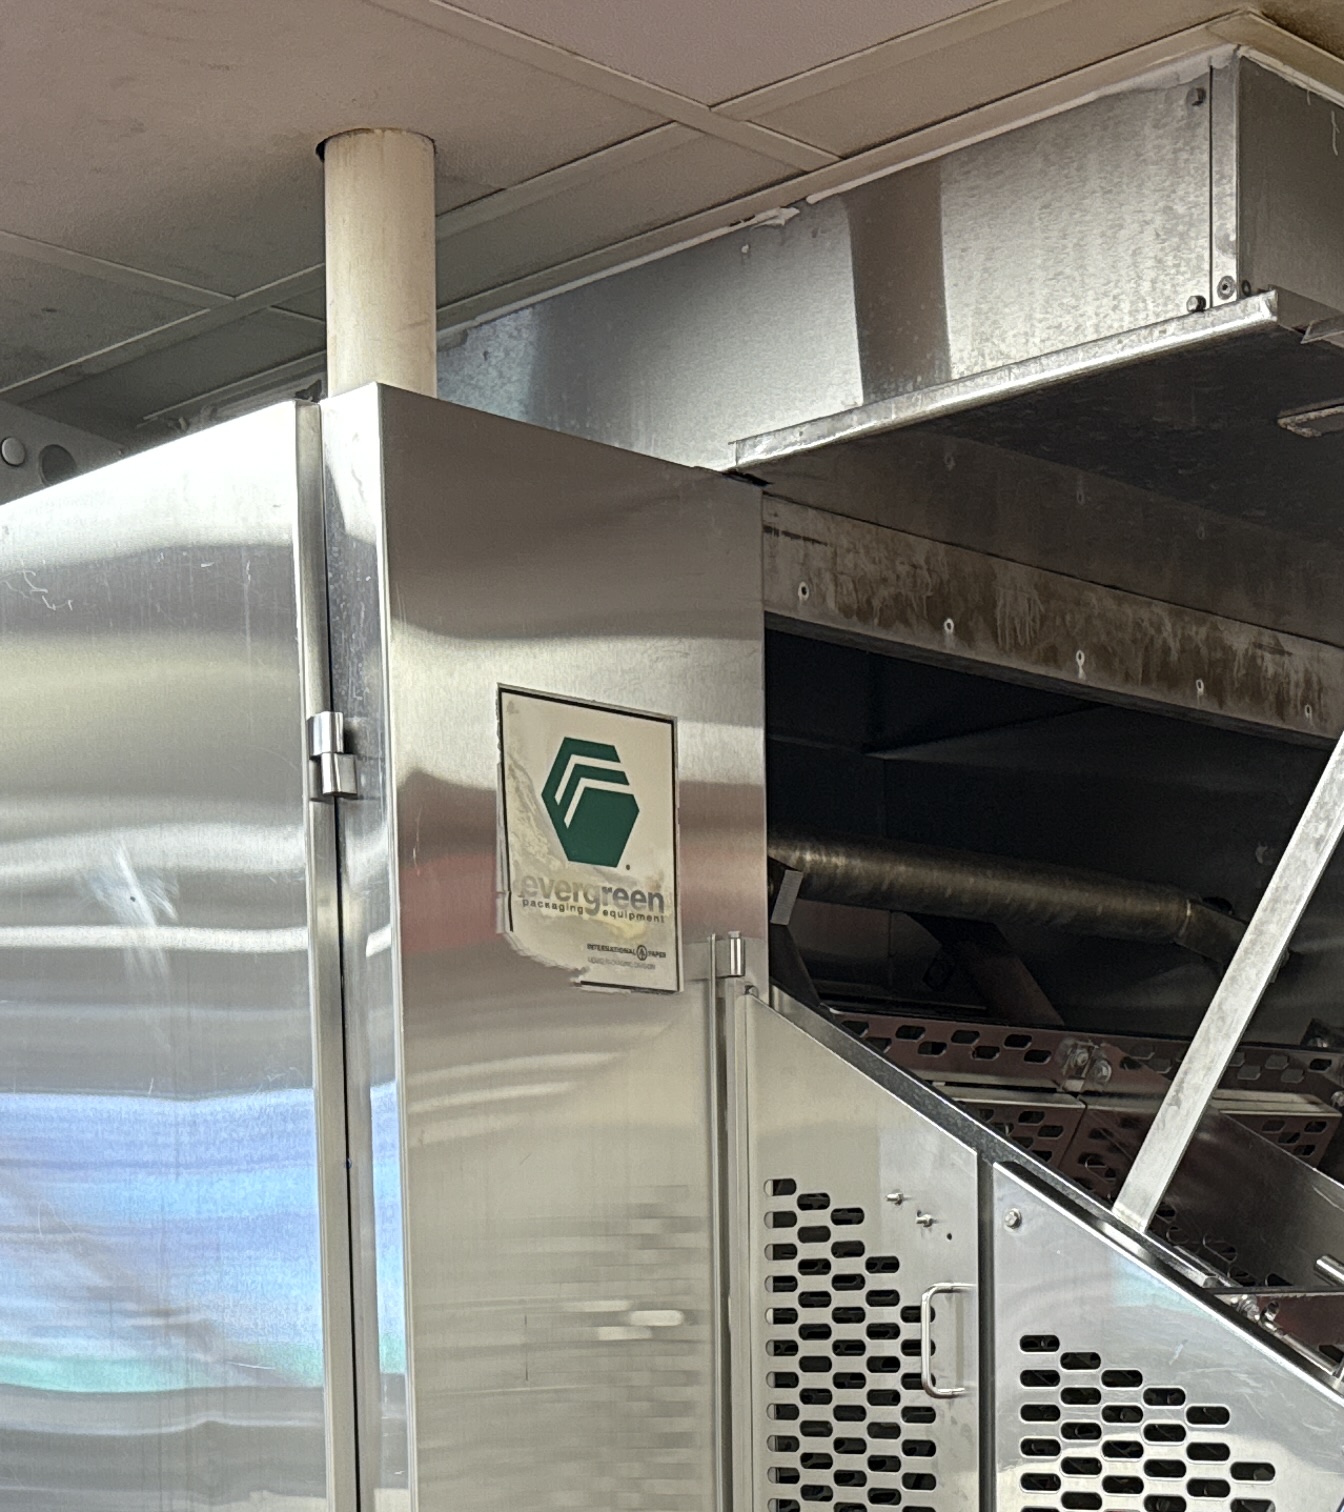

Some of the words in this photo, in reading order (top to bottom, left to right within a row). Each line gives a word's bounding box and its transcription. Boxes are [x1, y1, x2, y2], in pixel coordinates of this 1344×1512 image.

[520, 875, 665, 916] evergreen
[522, 899, 584, 915] packaging
[602, 908, 665, 924] equipment
[587, 943, 636, 956] INTERNATIONAL
[648, 950, 667, 959] PAPER
